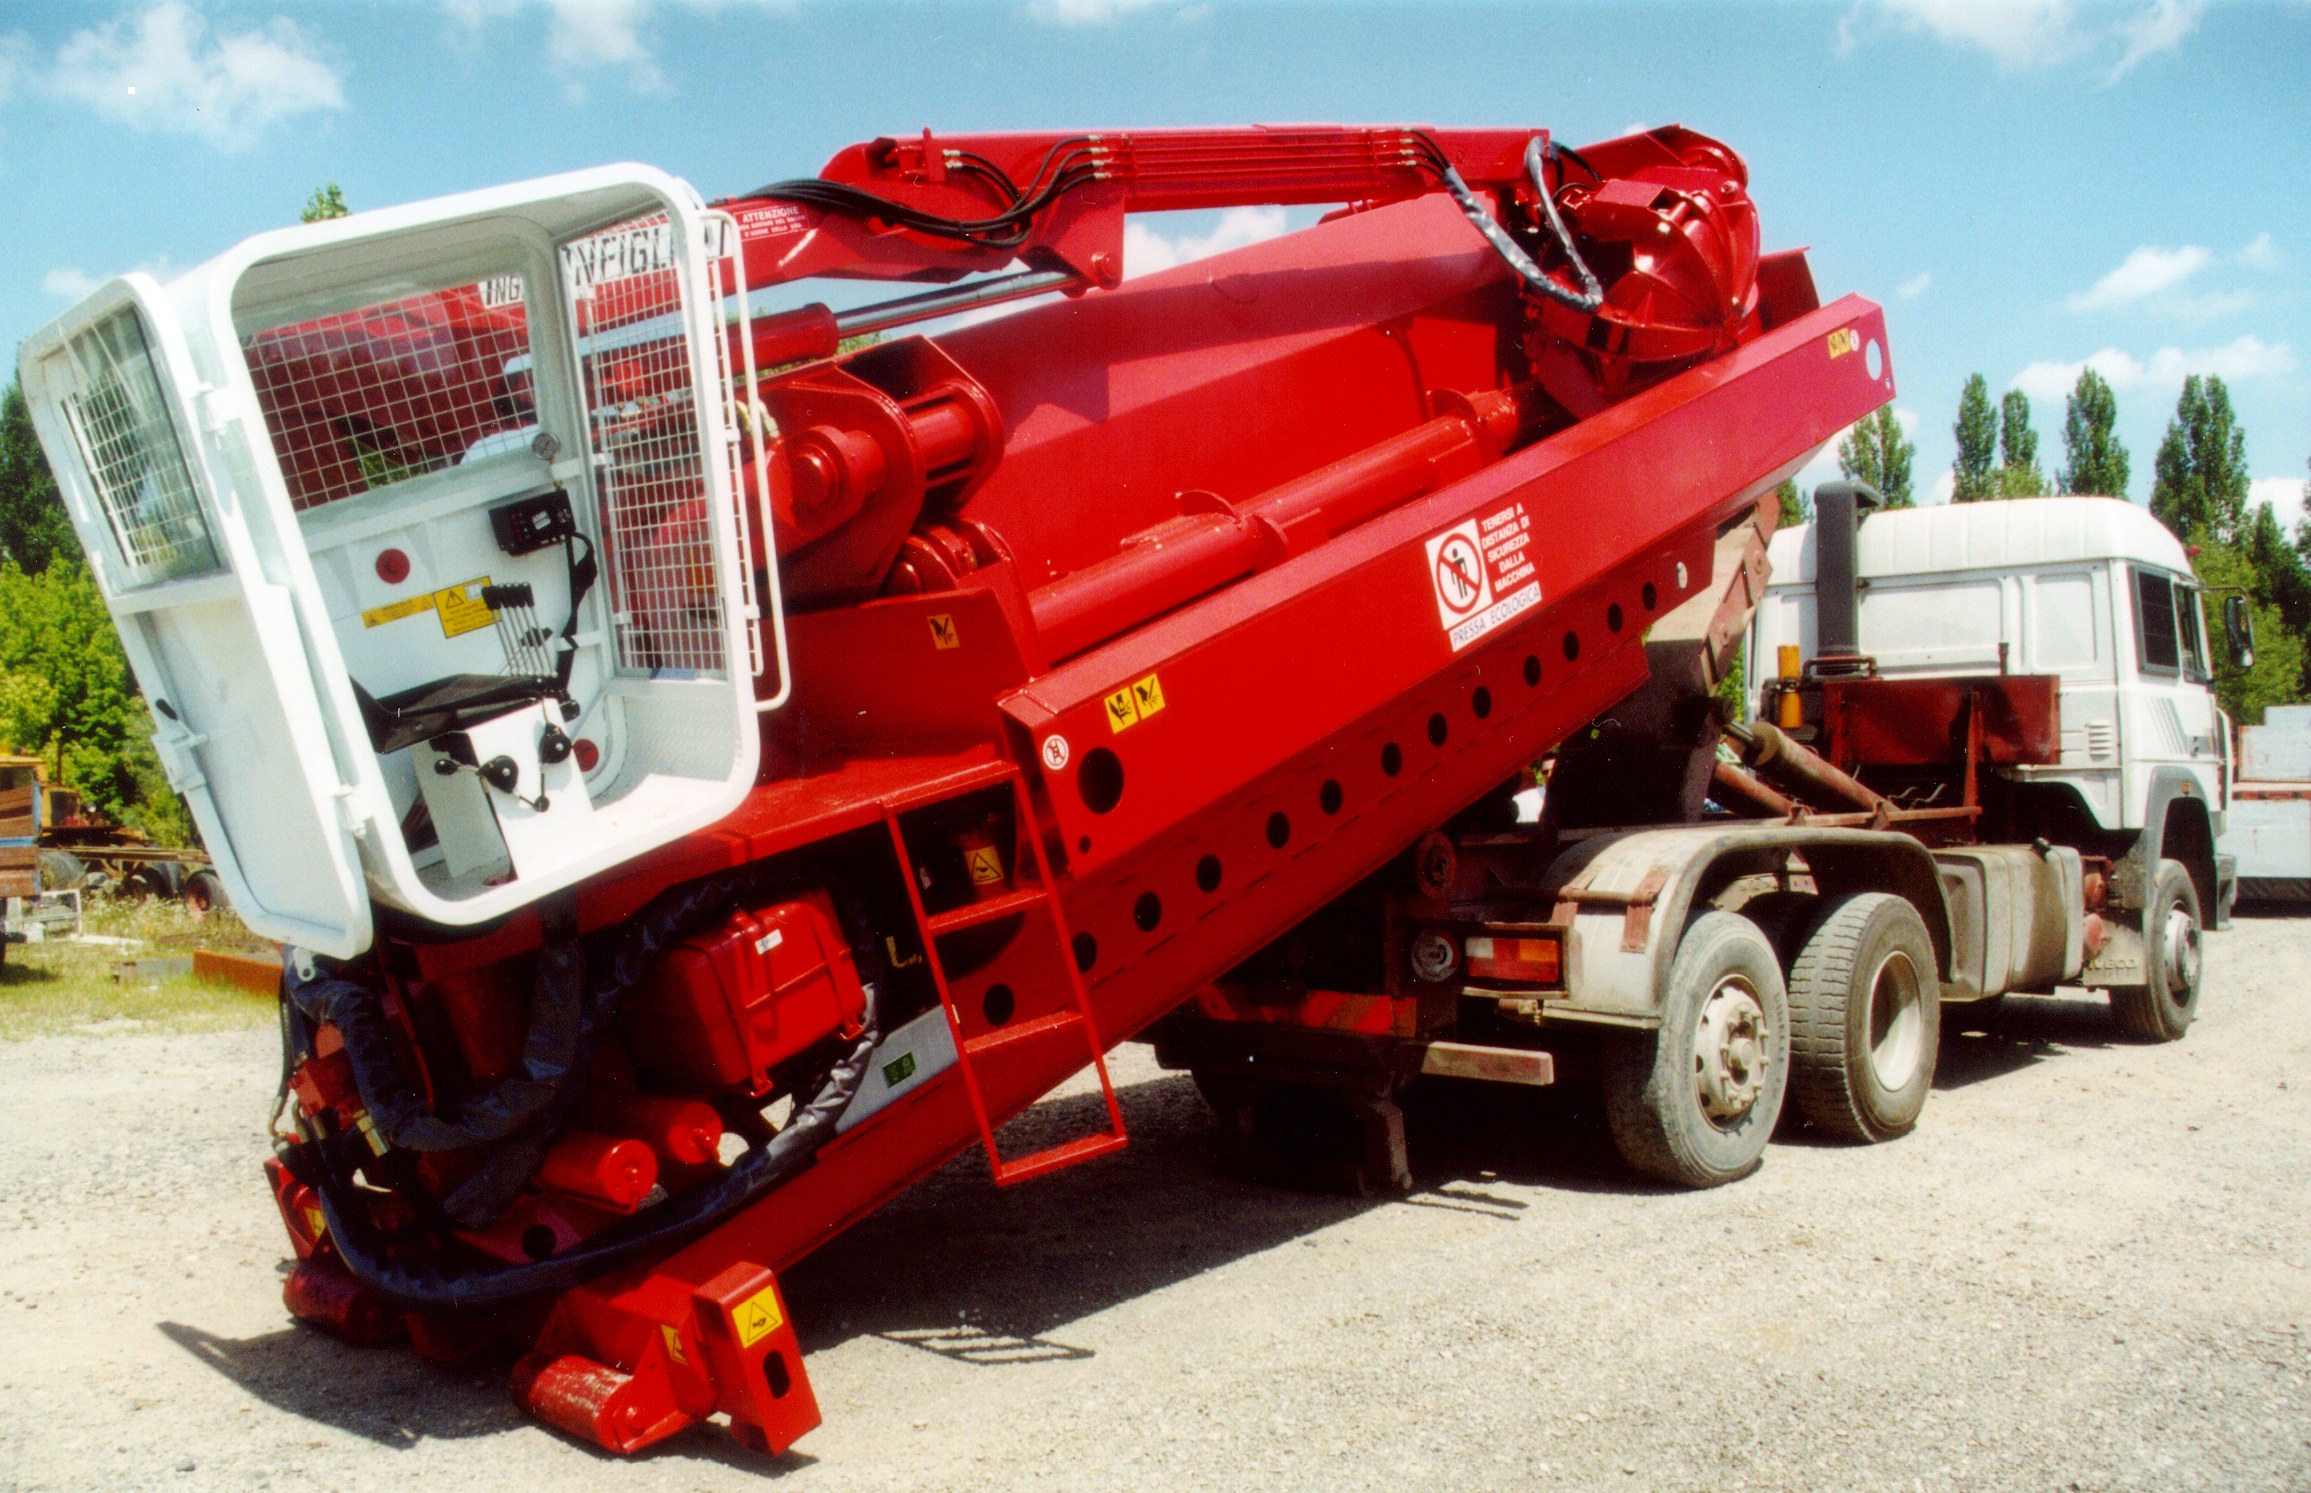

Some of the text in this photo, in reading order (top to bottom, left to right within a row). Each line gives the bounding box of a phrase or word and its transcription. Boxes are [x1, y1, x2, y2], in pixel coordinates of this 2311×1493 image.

[742, 206, 799, 223] ATTENZIONE
[1481, 502, 1524, 532] TENERSI A
[1481, 515, 1531, 550] DISTANZA DI
[1488, 532, 1531, 563] SICUREZZA
[1499, 551, 1525, 574] DALLA
[1494, 562, 1536, 593] MACCHINA
[1453, 585, 1539, 645] PRESSA ECOLOGICA
